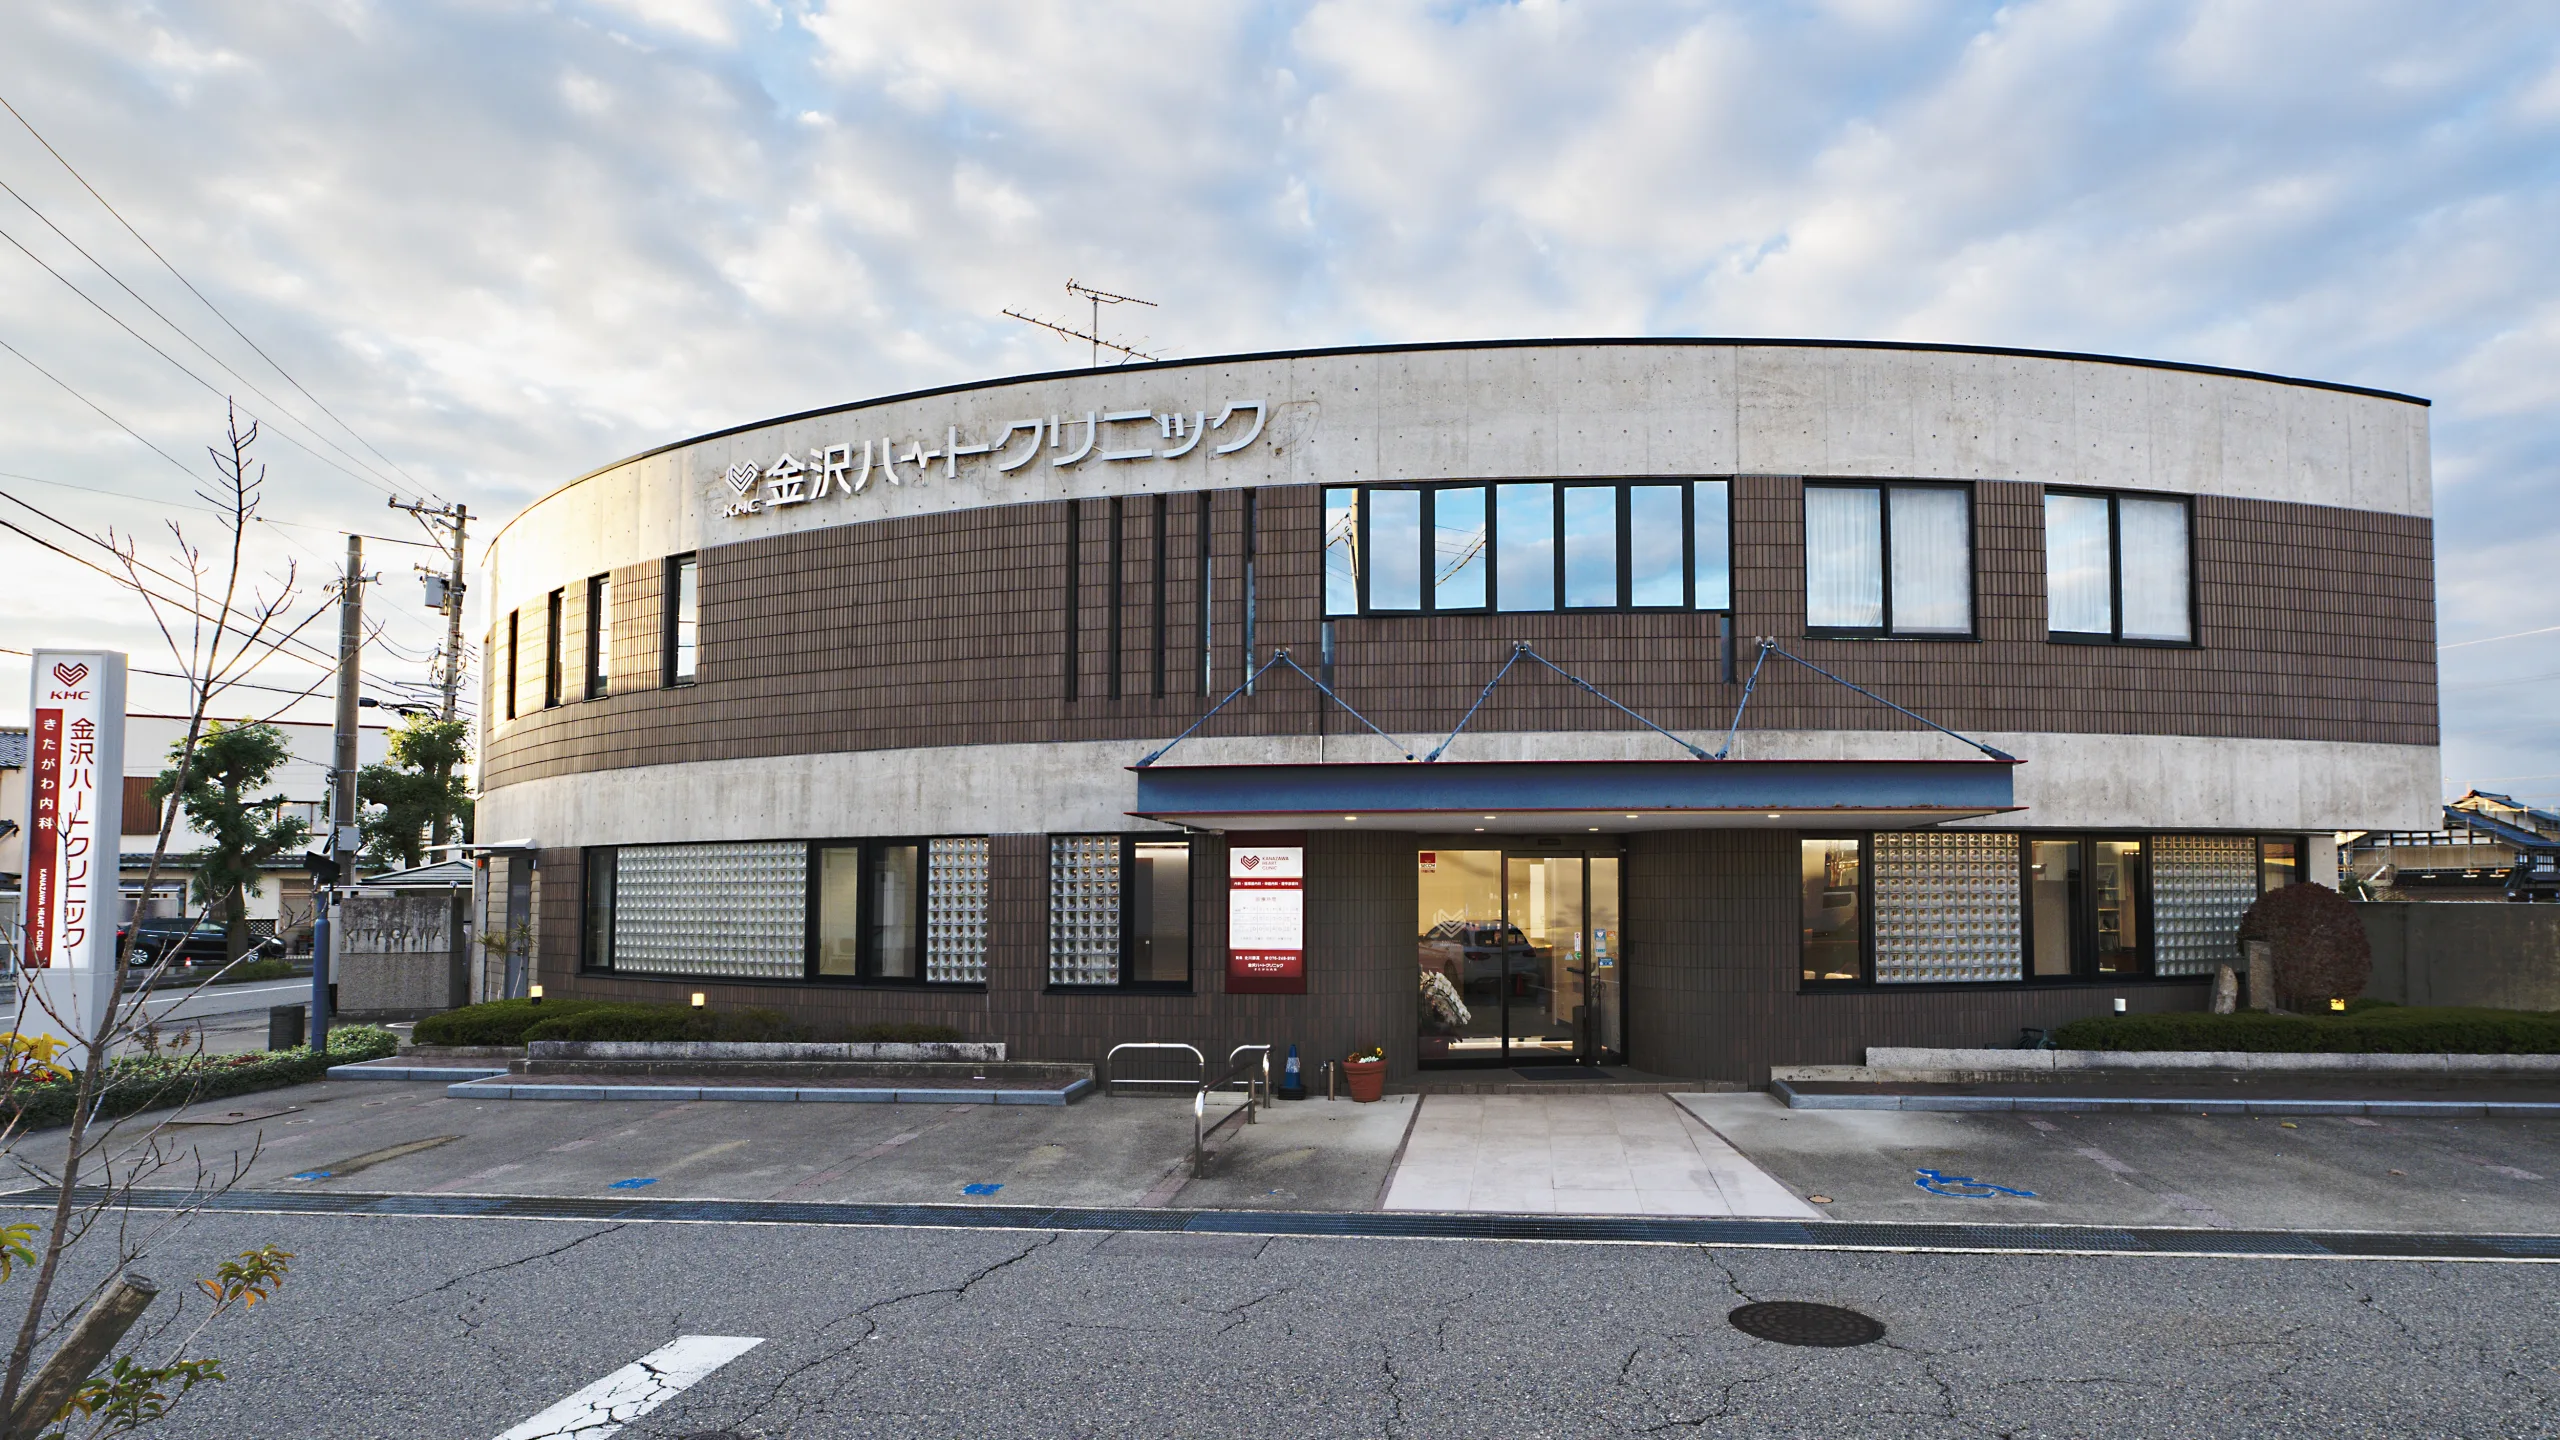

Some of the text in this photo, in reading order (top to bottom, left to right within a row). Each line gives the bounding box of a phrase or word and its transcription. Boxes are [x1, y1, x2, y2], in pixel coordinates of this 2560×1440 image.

[766, 399, 1267, 507] 金沢ハートクリニック
[723, 498, 761, 518] KHC
[50, 690, 91, 701] KHC
[38, 718, 58, 830] きたがわ内科
[62, 717, 96, 949] 金沢ハートクリニック
[35, 868, 48, 952] KANAZAWA HEART CLINIC
[344, 928, 446, 941] KITAGAWA
